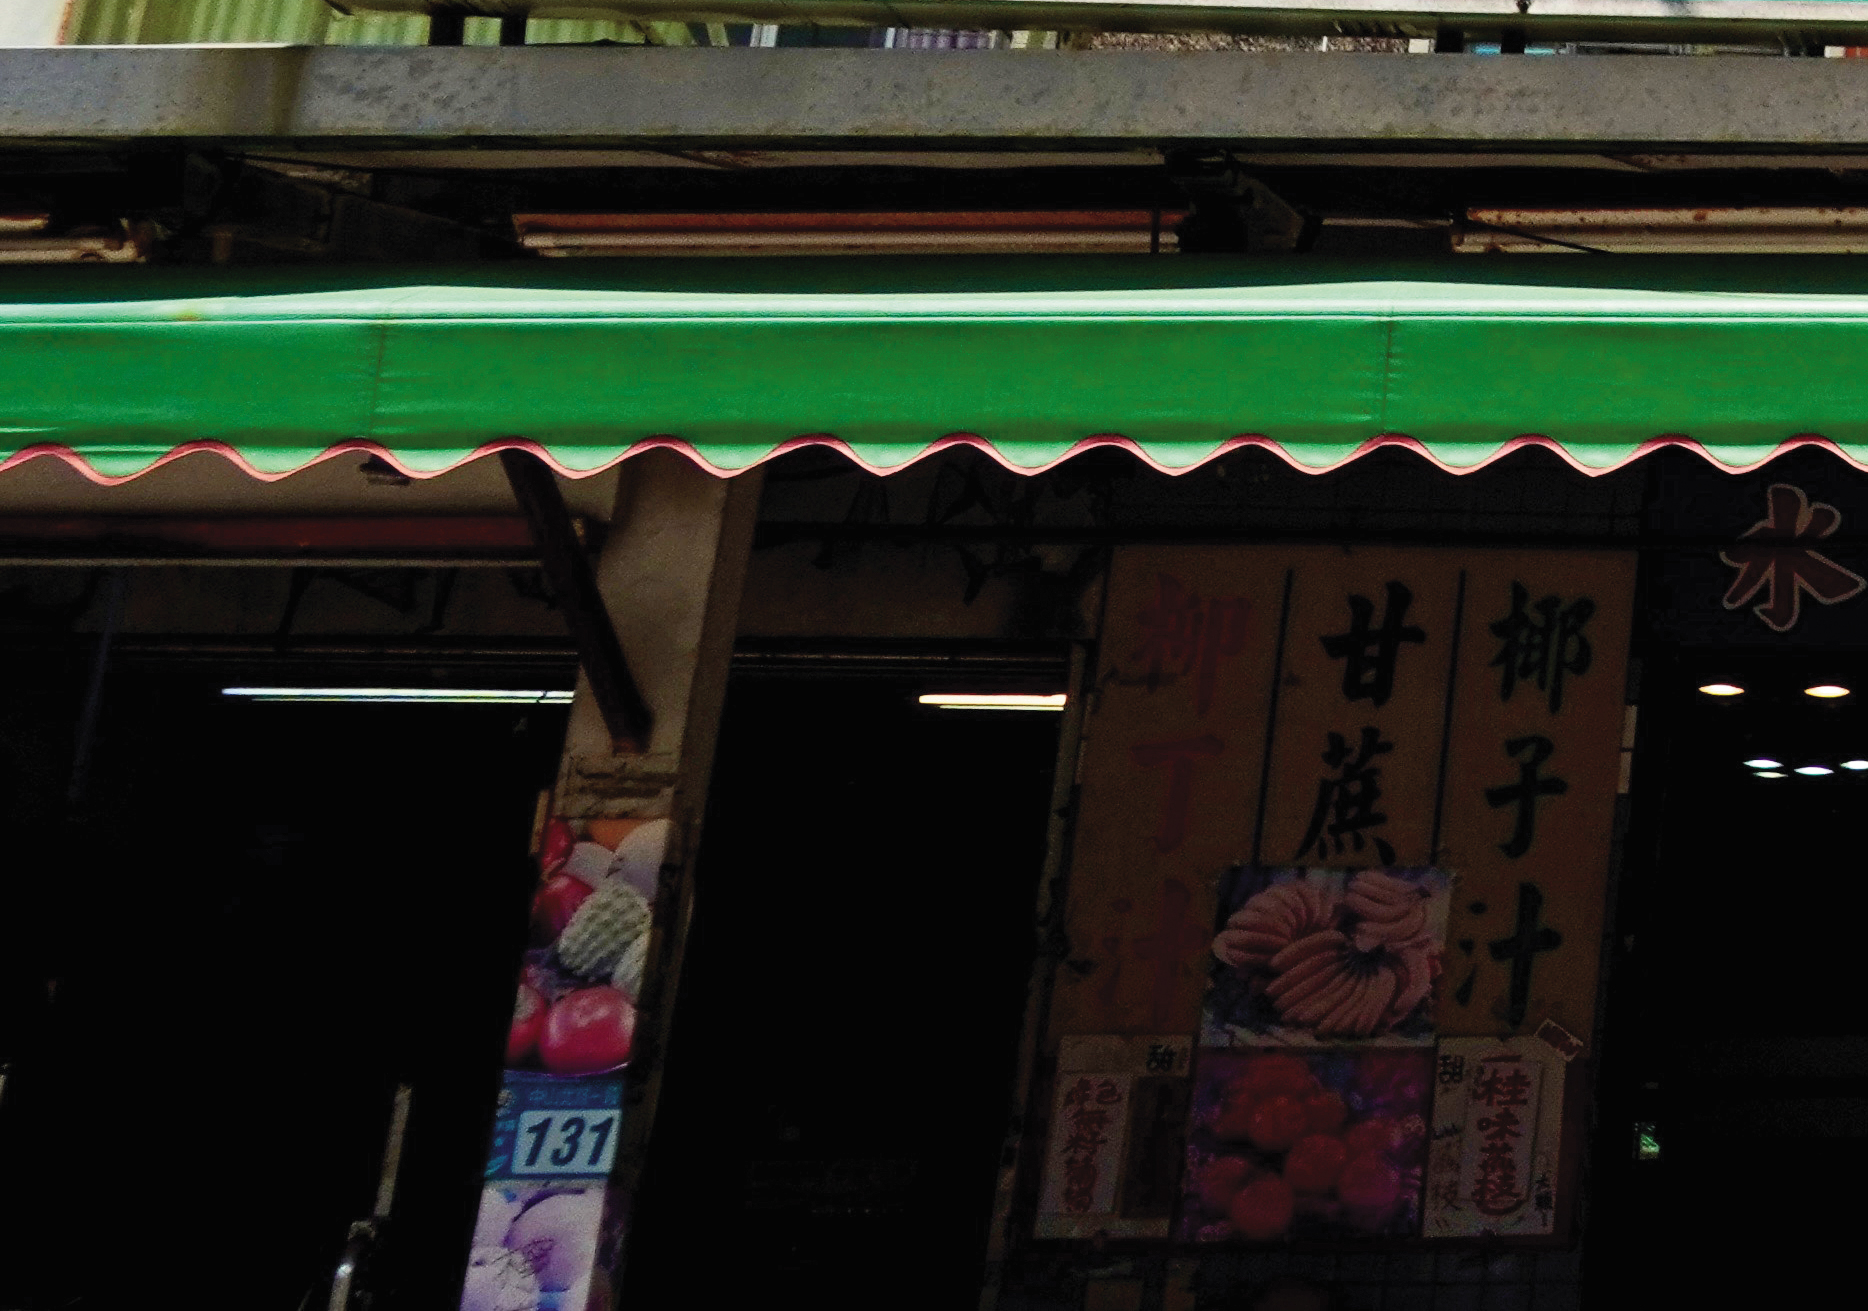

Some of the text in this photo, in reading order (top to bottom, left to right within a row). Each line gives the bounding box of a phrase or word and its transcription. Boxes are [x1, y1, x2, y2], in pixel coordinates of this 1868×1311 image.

[1296, 581, 1426, 865] 甘蔗
[1454, 581, 1596, 1027] 椰子汁
[525, 1117, 614, 1167] 131
